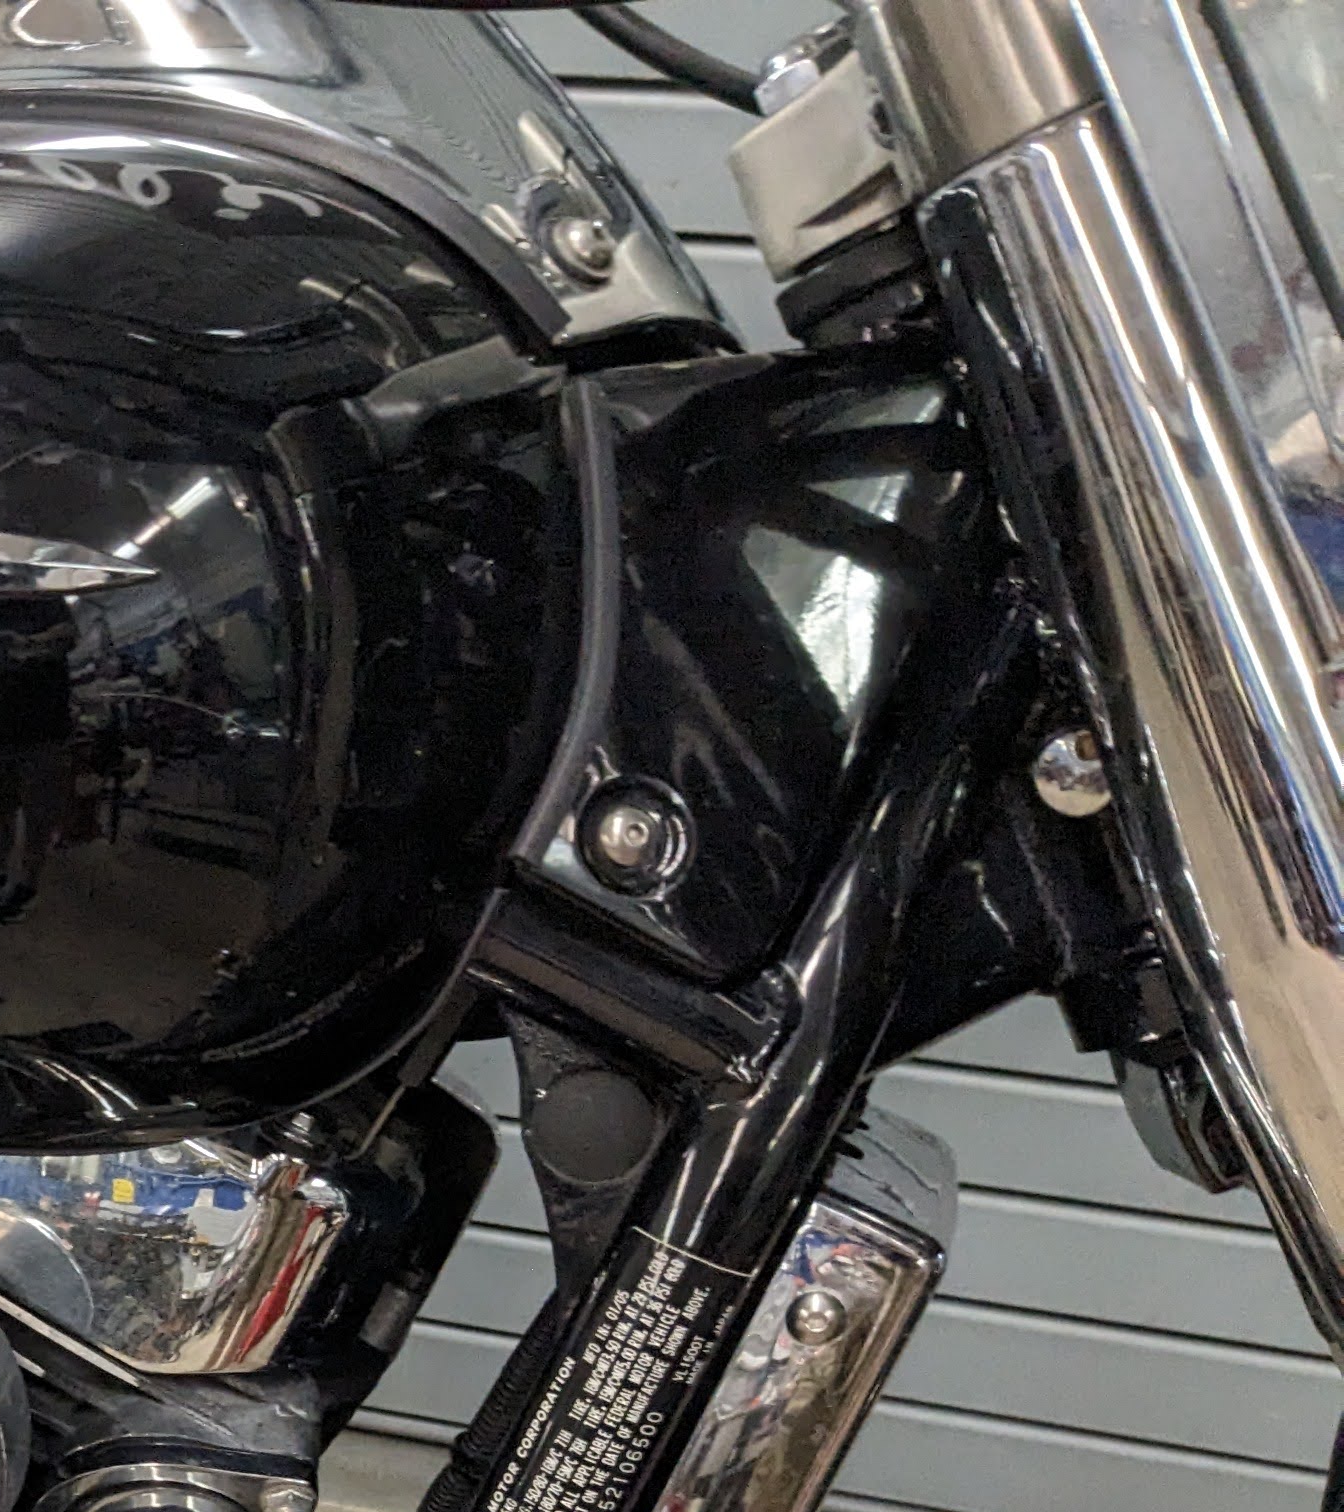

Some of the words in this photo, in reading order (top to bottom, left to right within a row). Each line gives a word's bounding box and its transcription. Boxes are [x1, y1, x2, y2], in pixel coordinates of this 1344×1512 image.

[582, 1342, 602, 1365] MFD
[605, 1289, 630, 1321] 01/05
[516, 1356, 577, 1459] CORPORATION
[553, 1429, 573, 1448] 71H
[559, 1491, 581, 1510] ALL
[571, 1428, 614, 1488] APPLICABLE
[603, 1387, 637, 1428] FEDERAL
[627, 1352, 655, 1385] MOTOR
[646, 1304, 681, 1348] VEHICLE
[589, 1467, 611, 1487] THE
[600, 1441, 625, 1467] DATE
[625, 1358, 670, 1424] MANUFACTURE
[660, 1324, 689, 1357] SHOWN
[681, 1287, 711, 1321] ABOVE.
